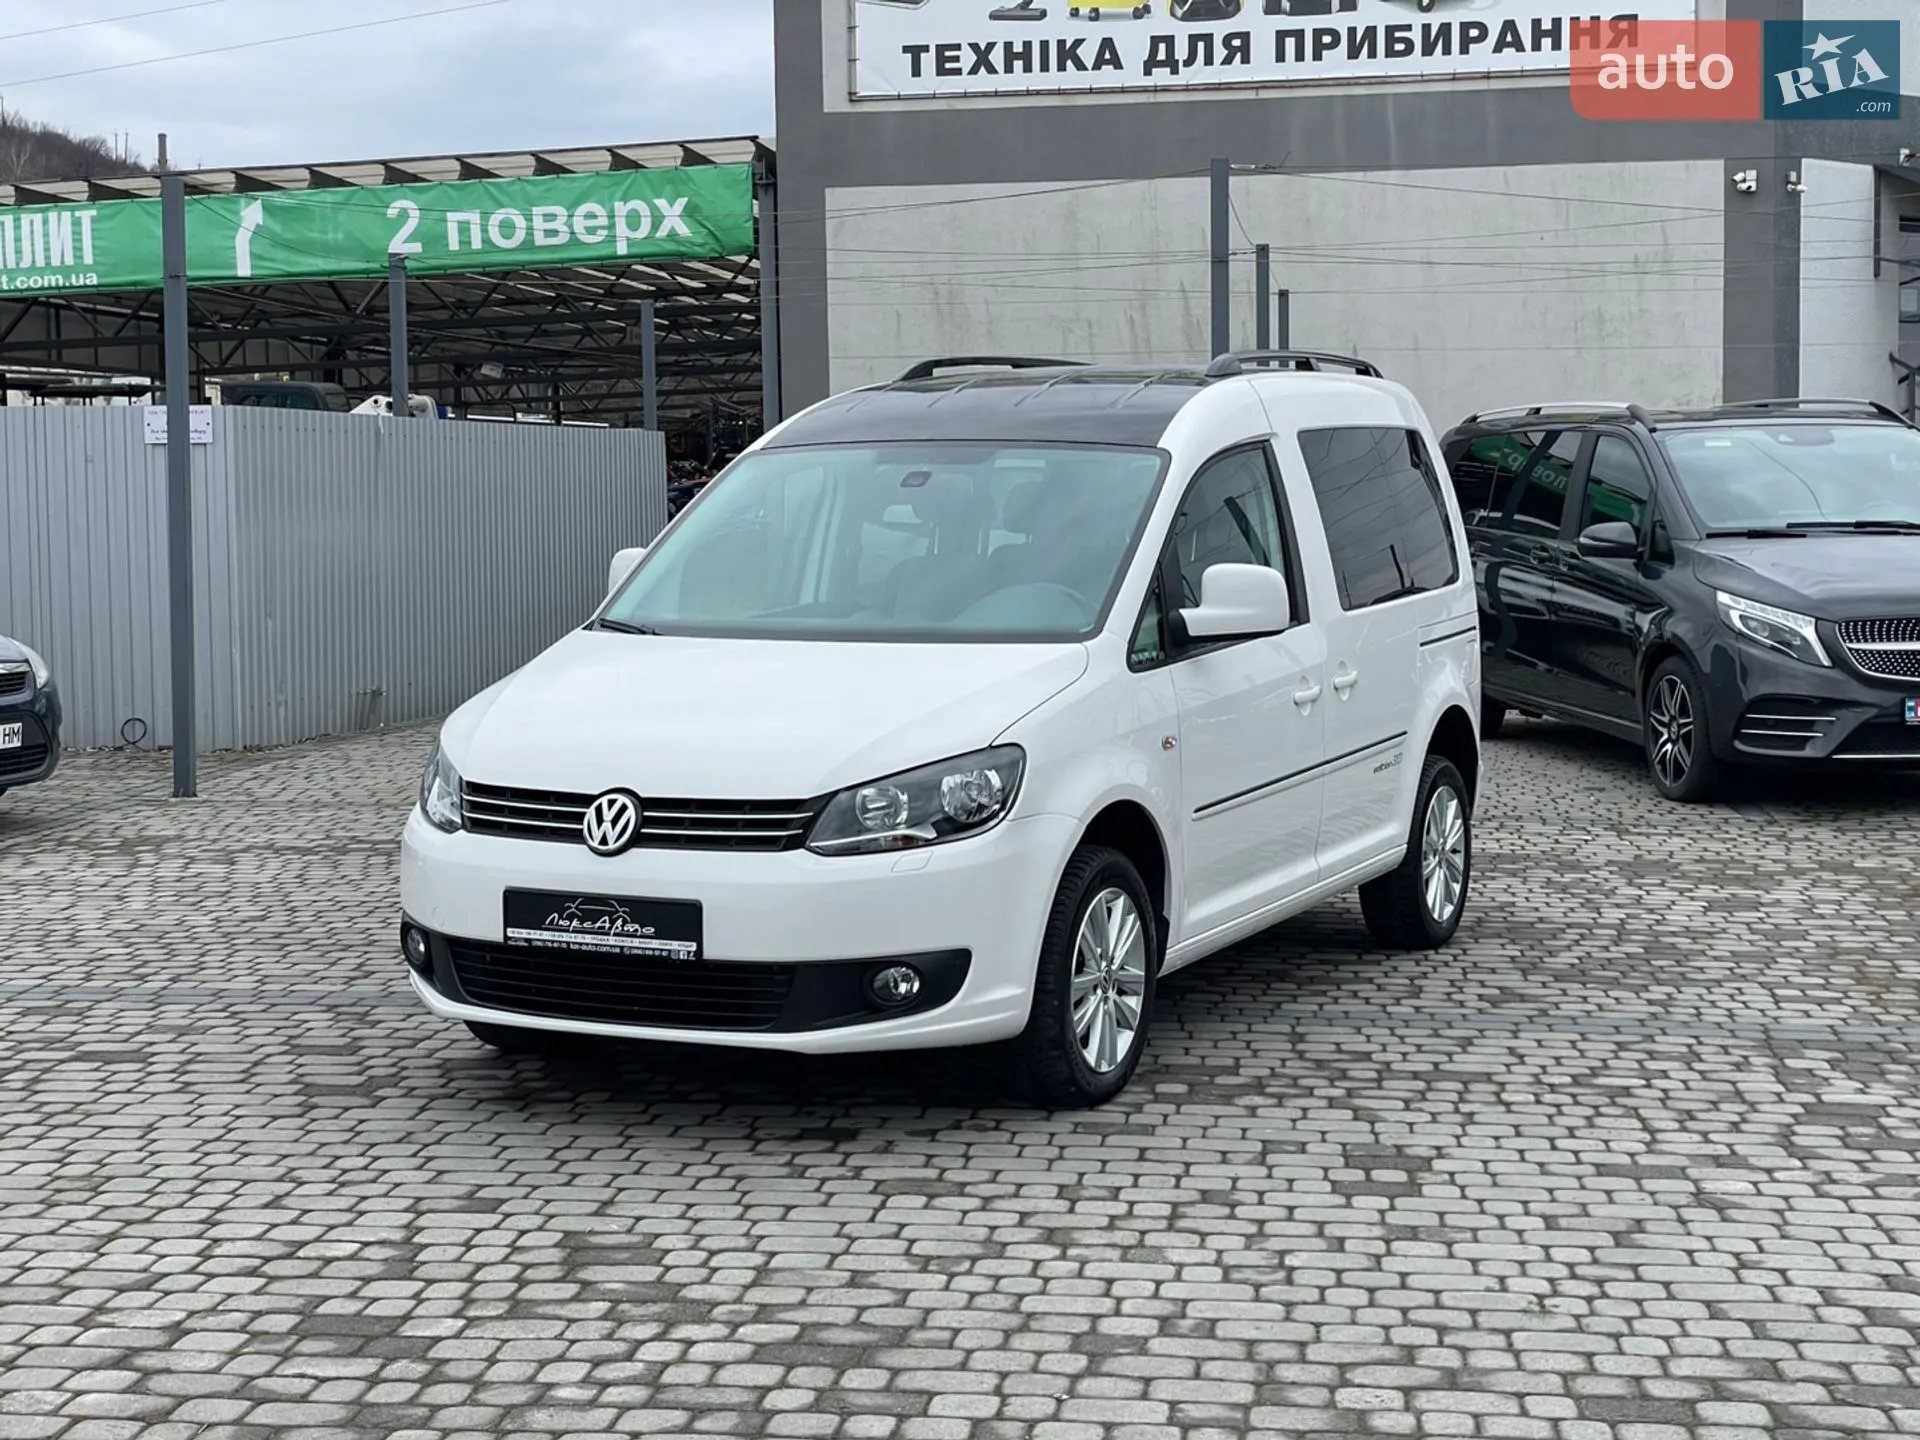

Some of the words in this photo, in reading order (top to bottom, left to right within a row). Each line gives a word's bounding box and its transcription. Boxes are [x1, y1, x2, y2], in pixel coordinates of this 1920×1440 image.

[902, 37, 1124, 78] ТЕХНІКА
[1143, 31, 1251, 76] ДЛЯ
[1275, 14, 1639, 63] ПРИБИРАННЯ
[386, 200, 422, 254] 2
[446, 197, 693, 255] поверх
[583, 793, 636, 850] VW
